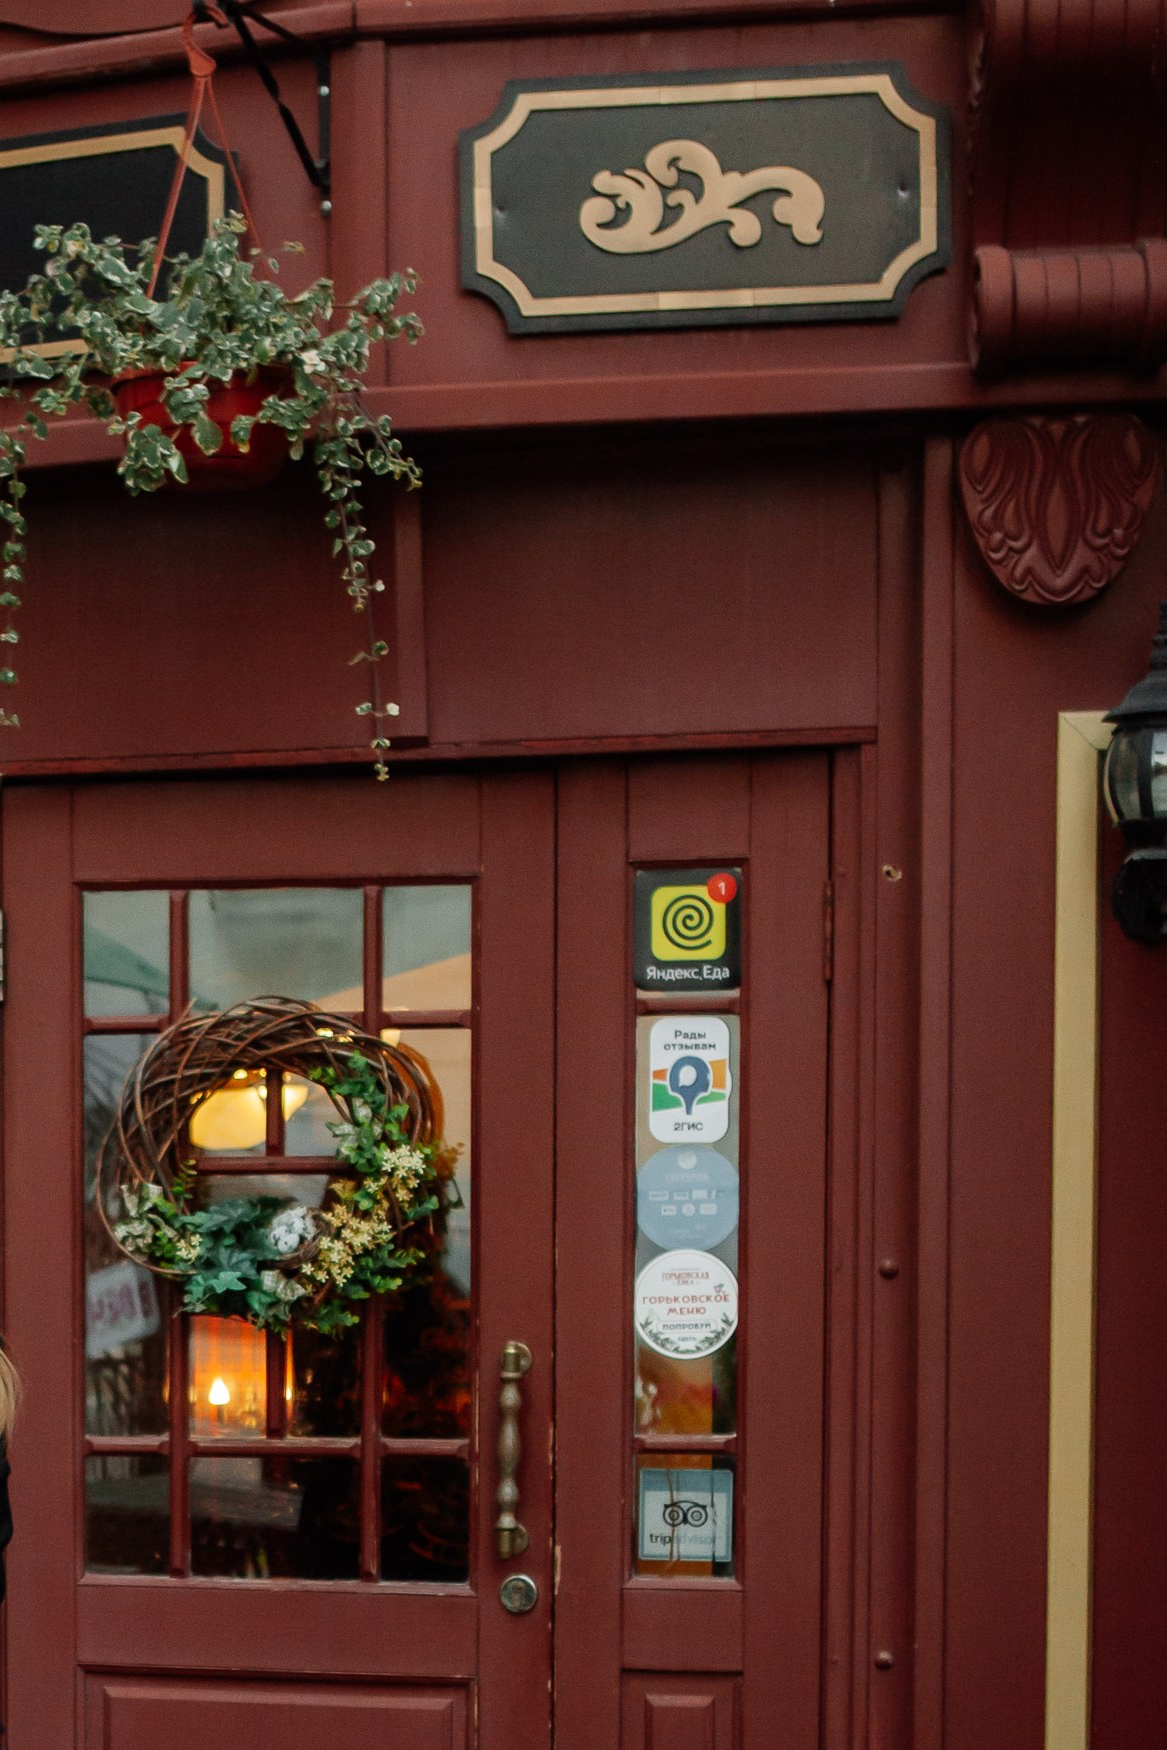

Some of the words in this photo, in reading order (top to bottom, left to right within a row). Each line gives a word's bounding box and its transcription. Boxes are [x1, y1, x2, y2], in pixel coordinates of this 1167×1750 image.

[717, 882, 727, 896] 1
[646, 965, 731, 982] Яндекс.Еда
[674, 1030, 707, 1042] Рады
[663, 1044, 717, 1052] отзывам
[674, 1122, 704, 1131] 2ГИС
[642, 1295, 730, 1305] ГОРЬКОВСКОЕ
[667, 1307, 707, 1316] МЕНЮ
[649, 1533, 723, 1547] tripdviso
